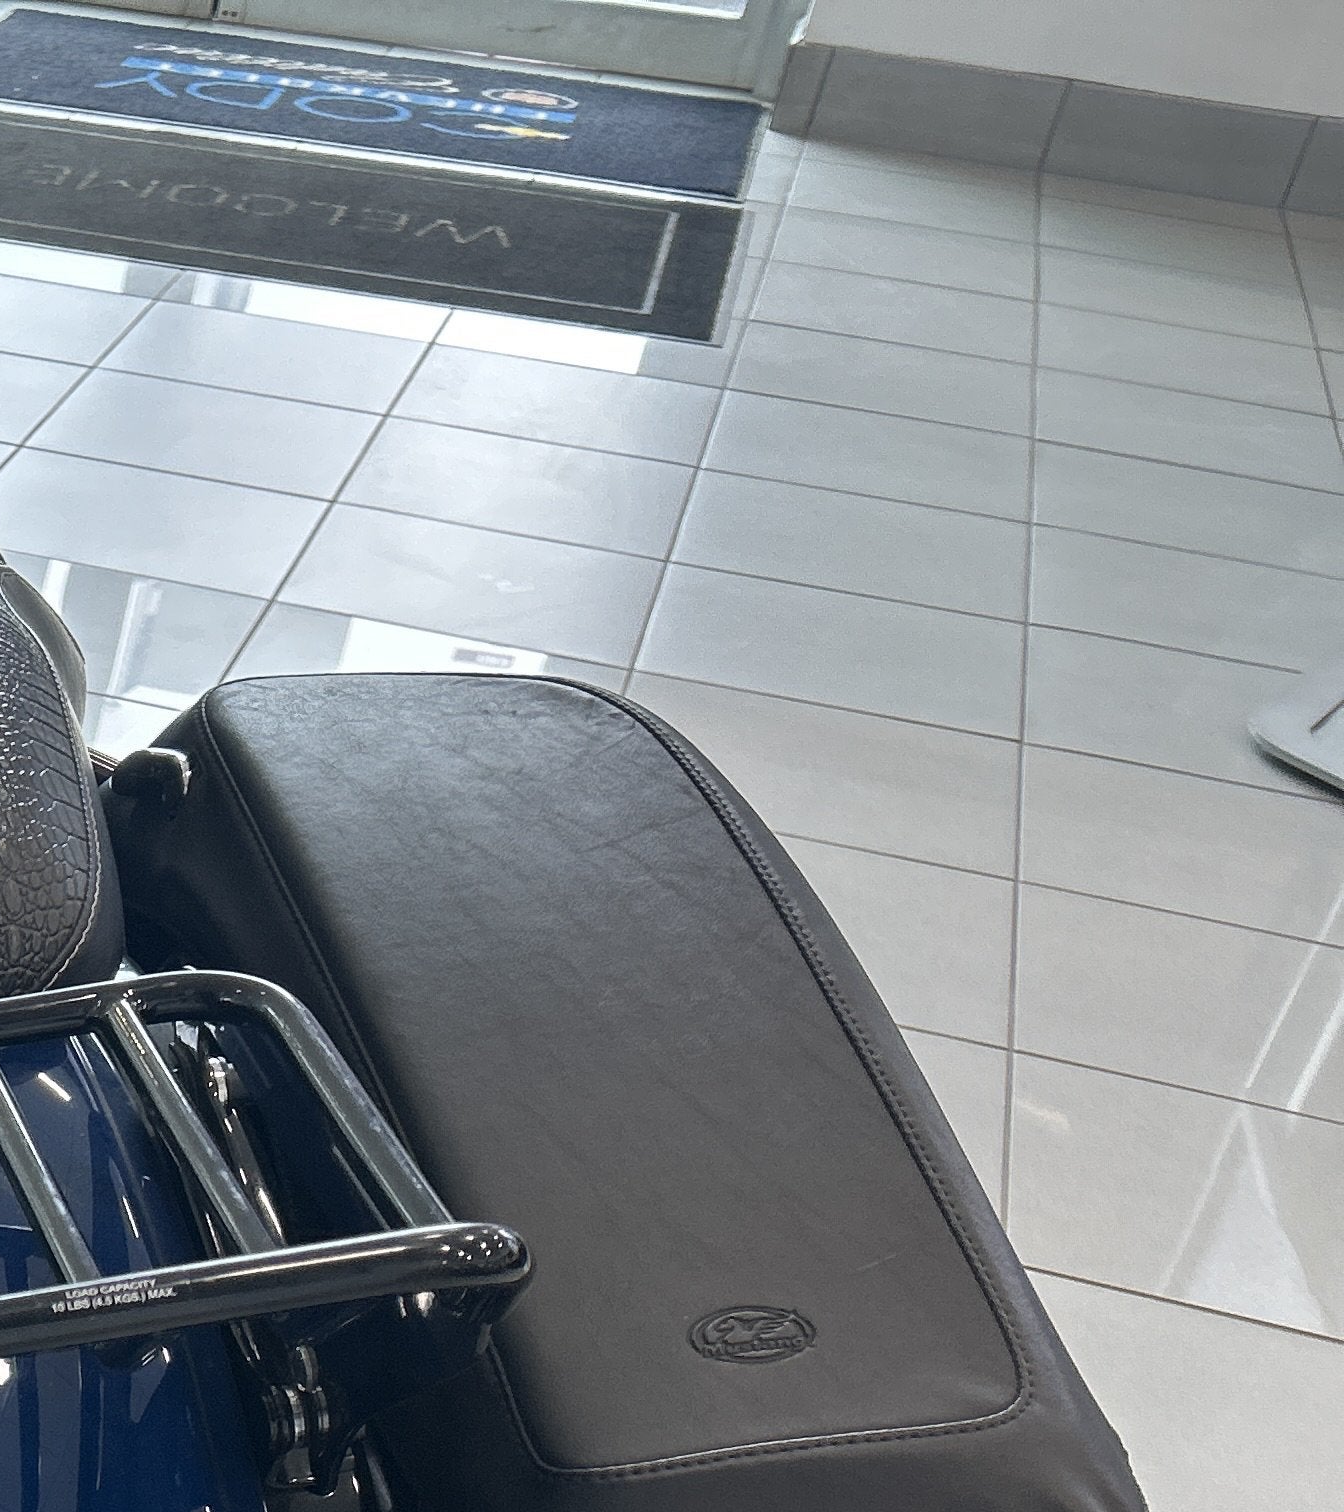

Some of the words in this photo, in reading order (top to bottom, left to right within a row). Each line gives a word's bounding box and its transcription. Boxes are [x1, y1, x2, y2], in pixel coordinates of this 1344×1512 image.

[94, 70, 532, 140] CODY
[28, 164, 510, 249] WELCOME
[65, 1288, 99, 1299] LOAD
[99, 1279, 156, 1294] CAPACITY
